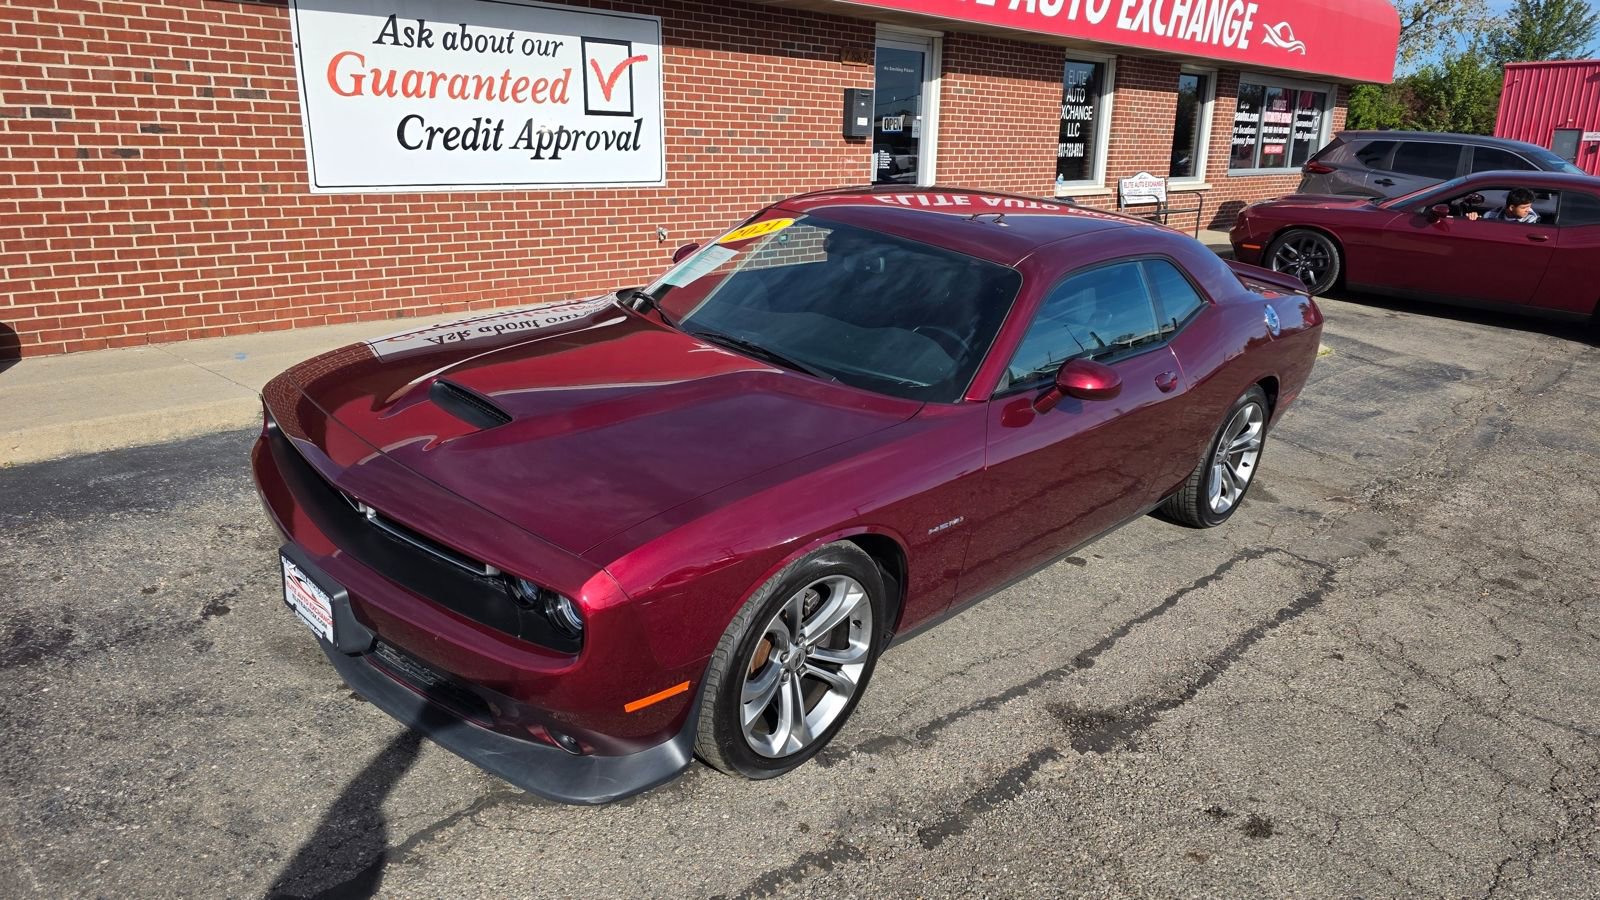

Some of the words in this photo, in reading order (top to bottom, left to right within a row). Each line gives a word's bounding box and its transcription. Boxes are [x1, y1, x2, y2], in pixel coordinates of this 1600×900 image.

[1116, 0, 1259, 50] EXCHANGE
[372, 13, 435, 49] Ask
[442, 23, 515, 54] about
[521, 37, 564, 58] our
[327, 50, 572, 105] Guaranteed
[1068, 69, 1087, 86] ELITE
[1066, 88, 1086, 103] AUTO
[1061, 105, 1094, 120] XCHANGE
[884, 117, 903, 130] OPEN
[1067, 122, 1081, 137] LLC
[396, 113, 505, 151] Credit
[509, 117, 644, 160] Approval
